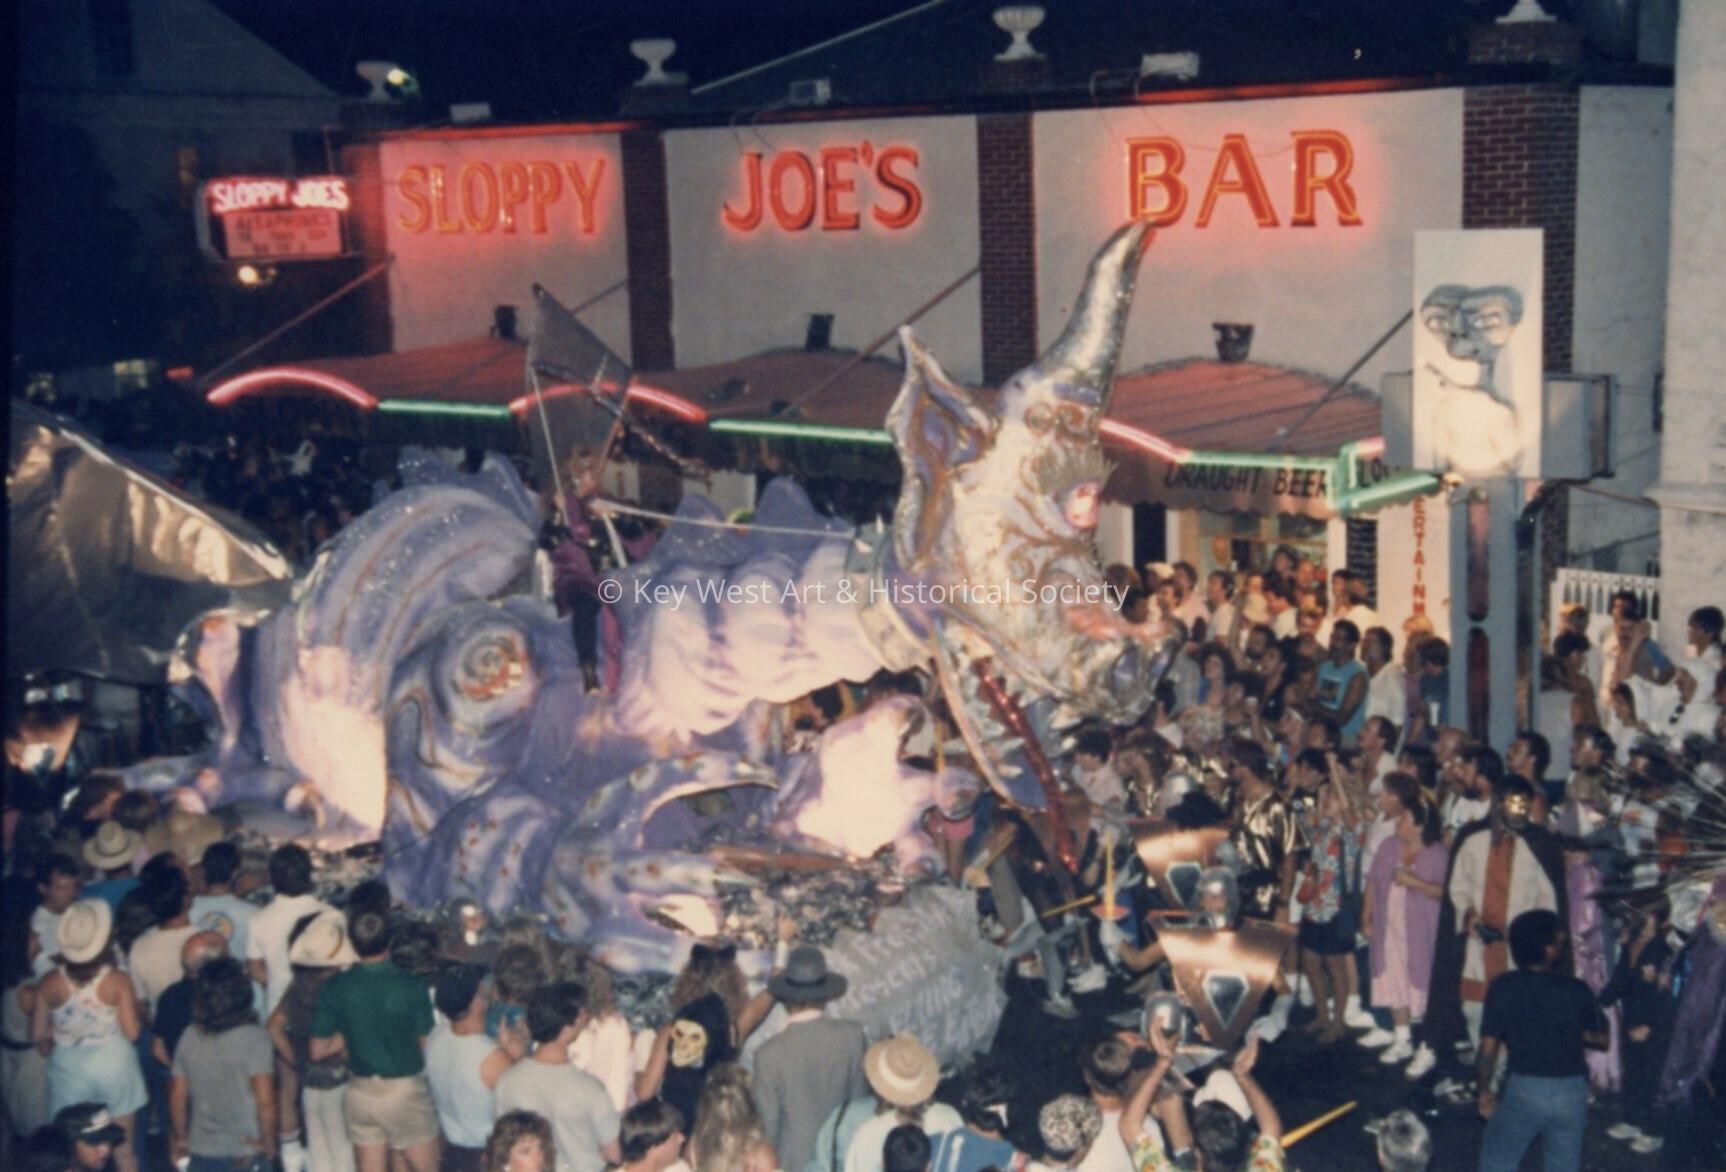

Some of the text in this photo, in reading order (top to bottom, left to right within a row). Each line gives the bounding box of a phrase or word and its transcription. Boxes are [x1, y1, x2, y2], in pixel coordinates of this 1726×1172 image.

[211, 180, 289, 214] SLOPPY
[398, 129, 1364, 234] SLOPPY JOE'S BAR
